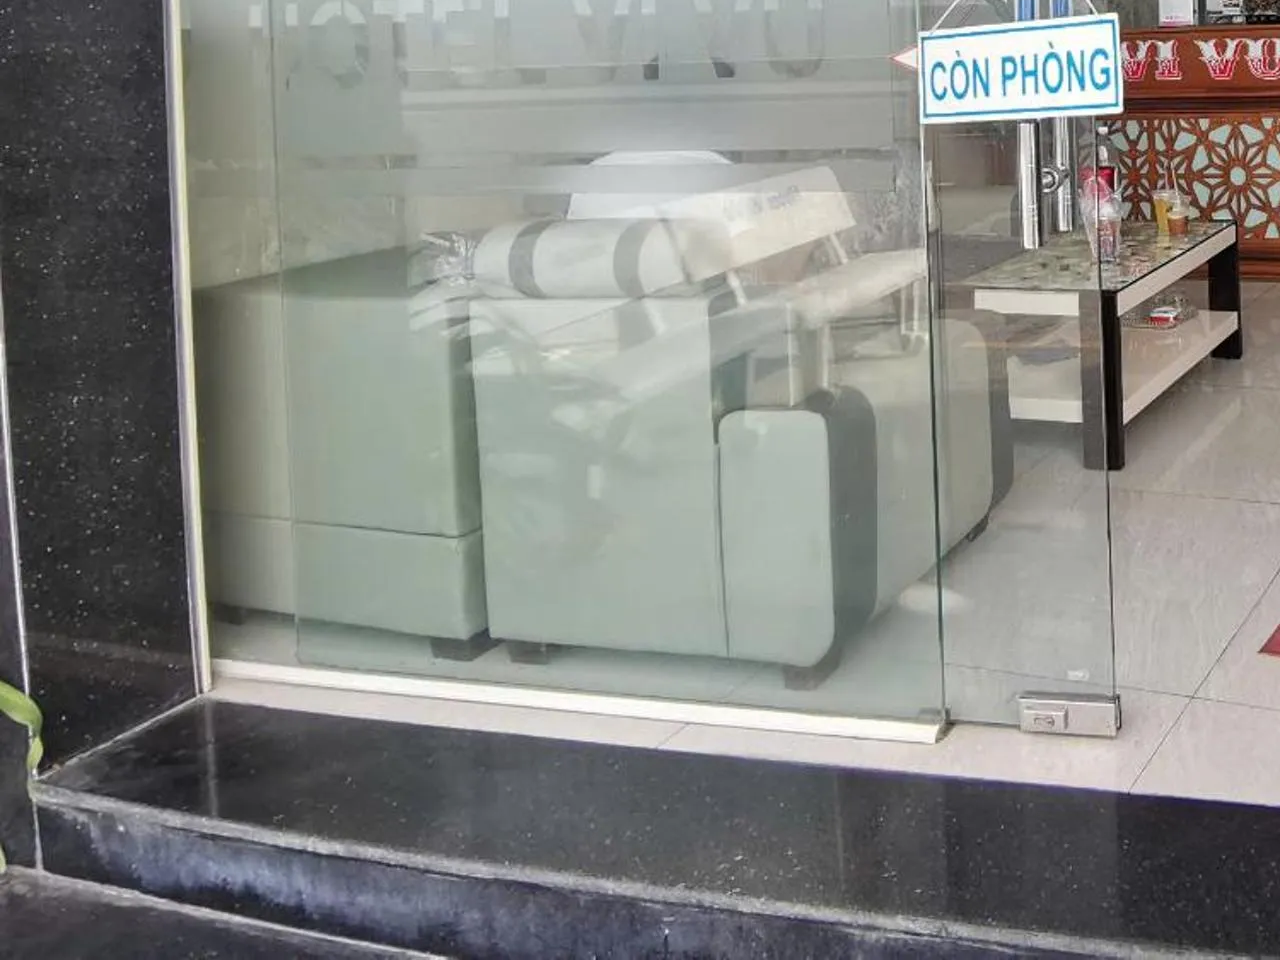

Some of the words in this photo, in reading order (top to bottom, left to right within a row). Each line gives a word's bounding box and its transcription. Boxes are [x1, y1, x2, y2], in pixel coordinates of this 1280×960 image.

[929, 50, 991, 102] CÒN
[1001, 40, 1112, 98] PHÒNG
[1120, 39, 1182, 81] VI
